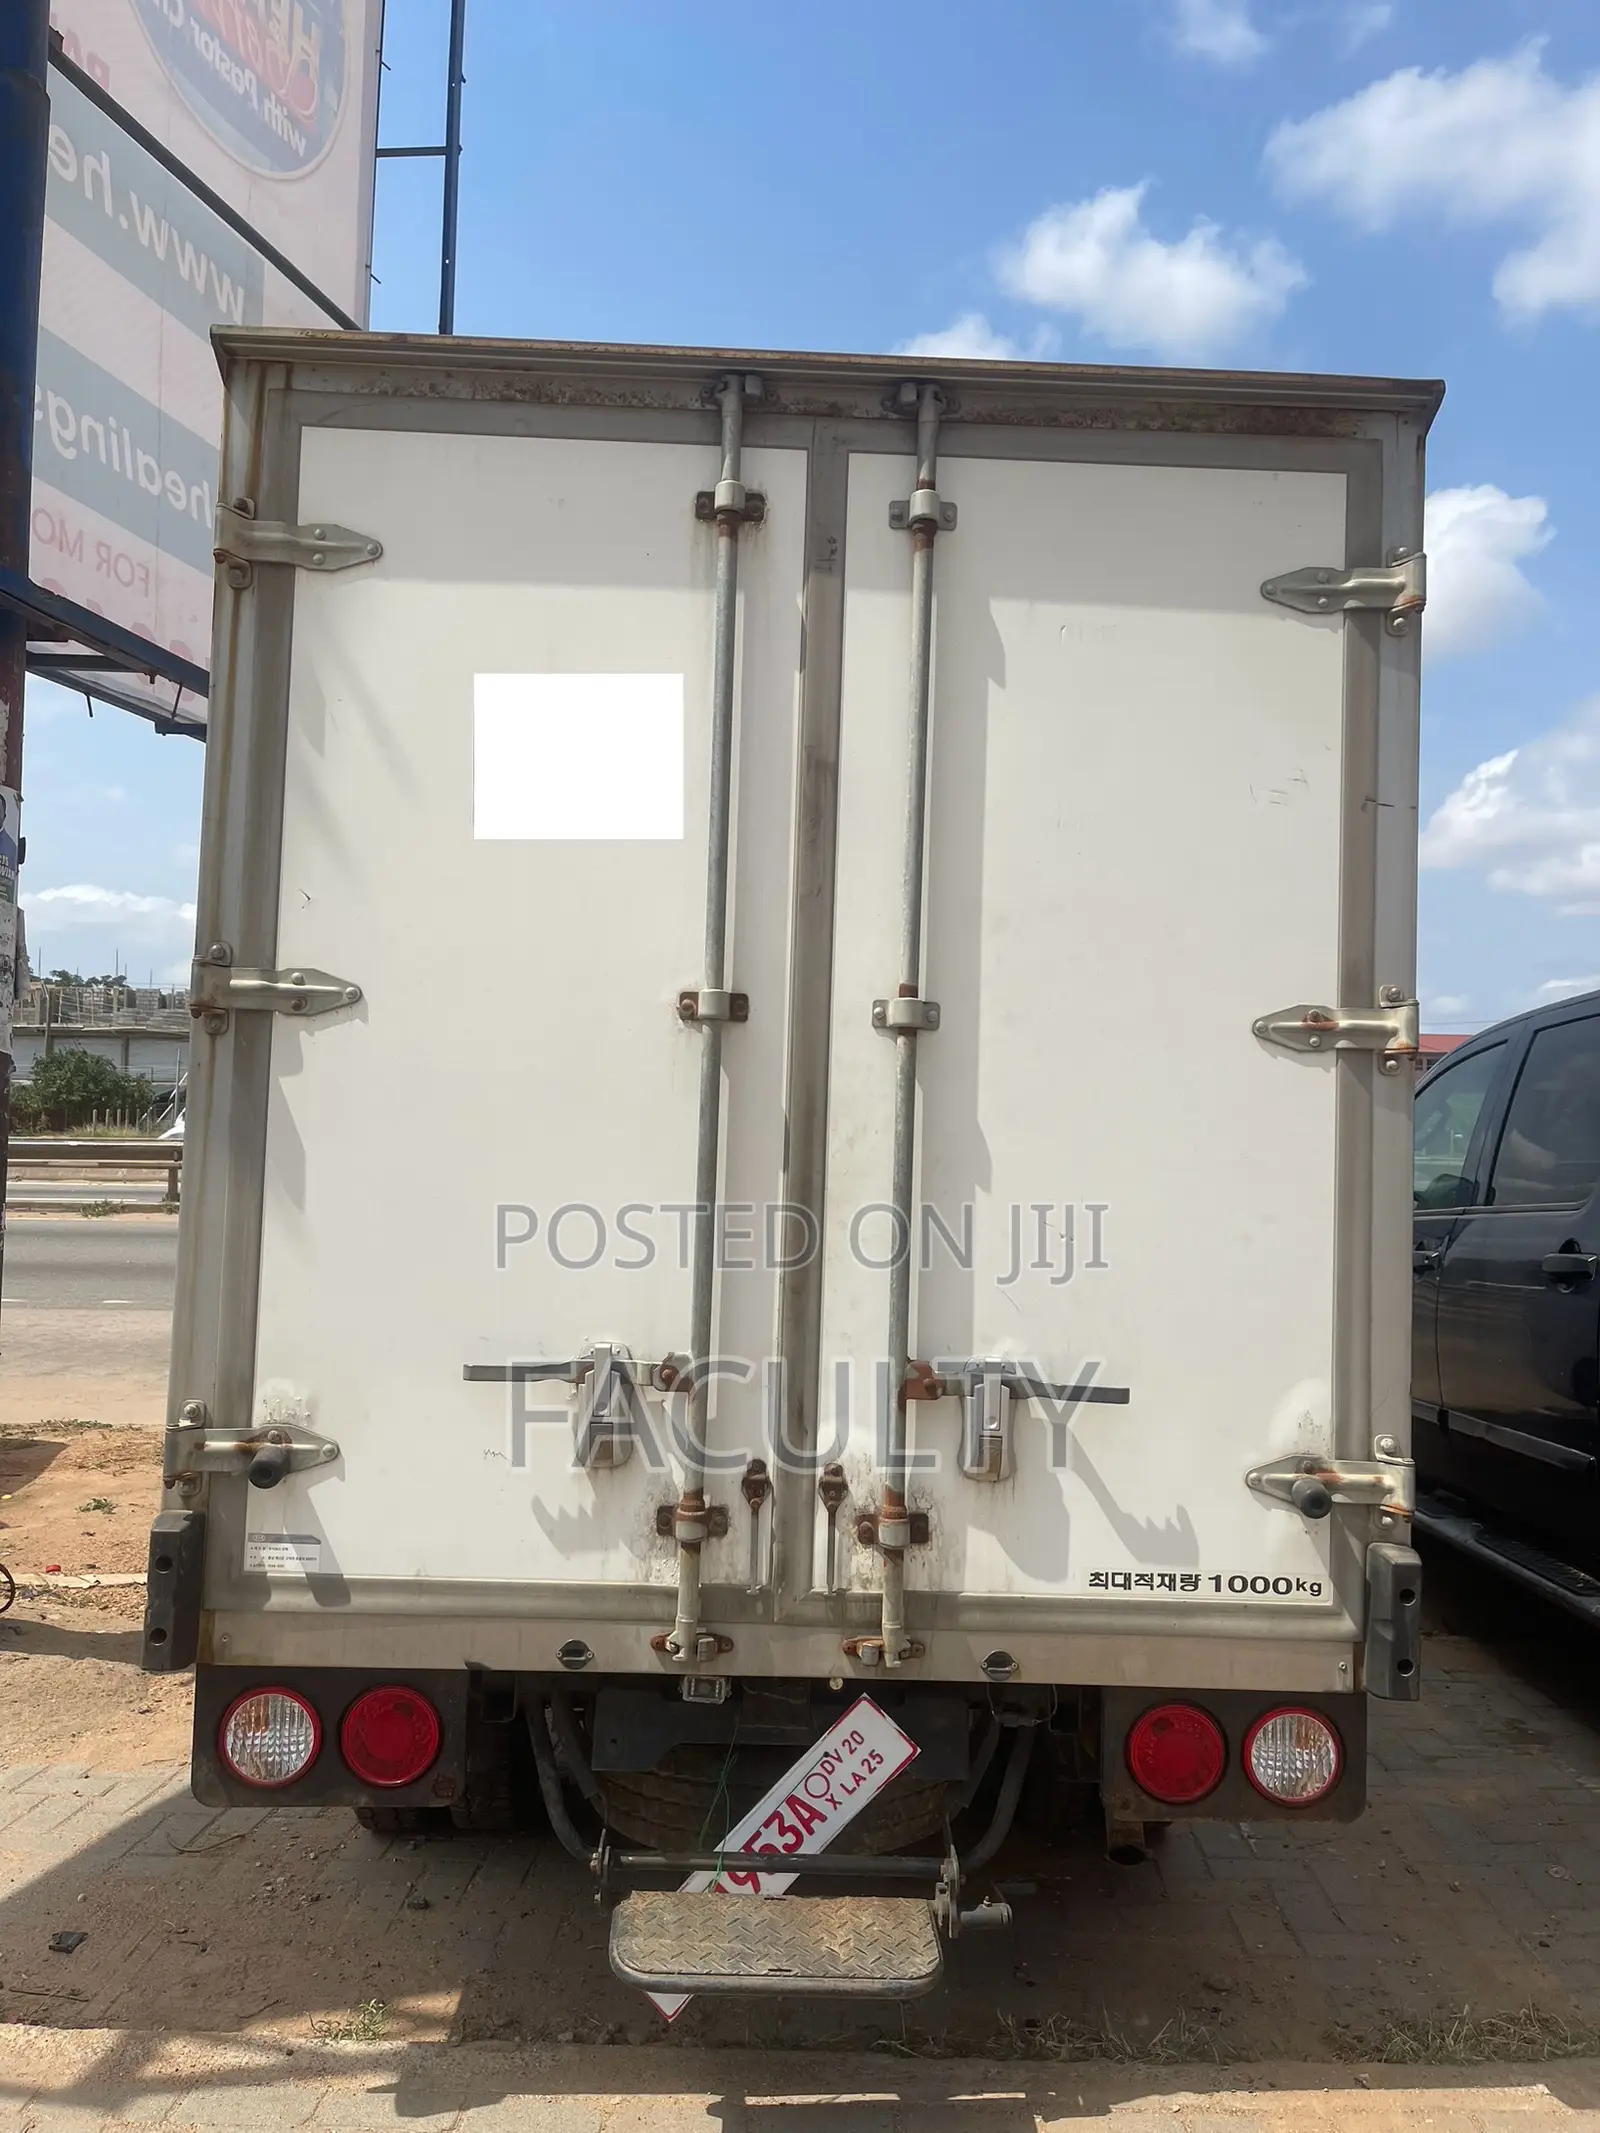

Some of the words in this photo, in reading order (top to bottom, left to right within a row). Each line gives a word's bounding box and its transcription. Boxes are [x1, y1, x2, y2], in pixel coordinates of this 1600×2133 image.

[1088, 1571, 1202, 1592] 최대적재량
[1208, 1574, 1322, 1597] 1000kg
[819, 1748, 844, 1776] DV
[841, 1730, 865, 1755] 20
[824, 1793, 843, 1811] X
[839, 1771, 867, 1796] LA
[861, 1749, 885, 1775] 25
